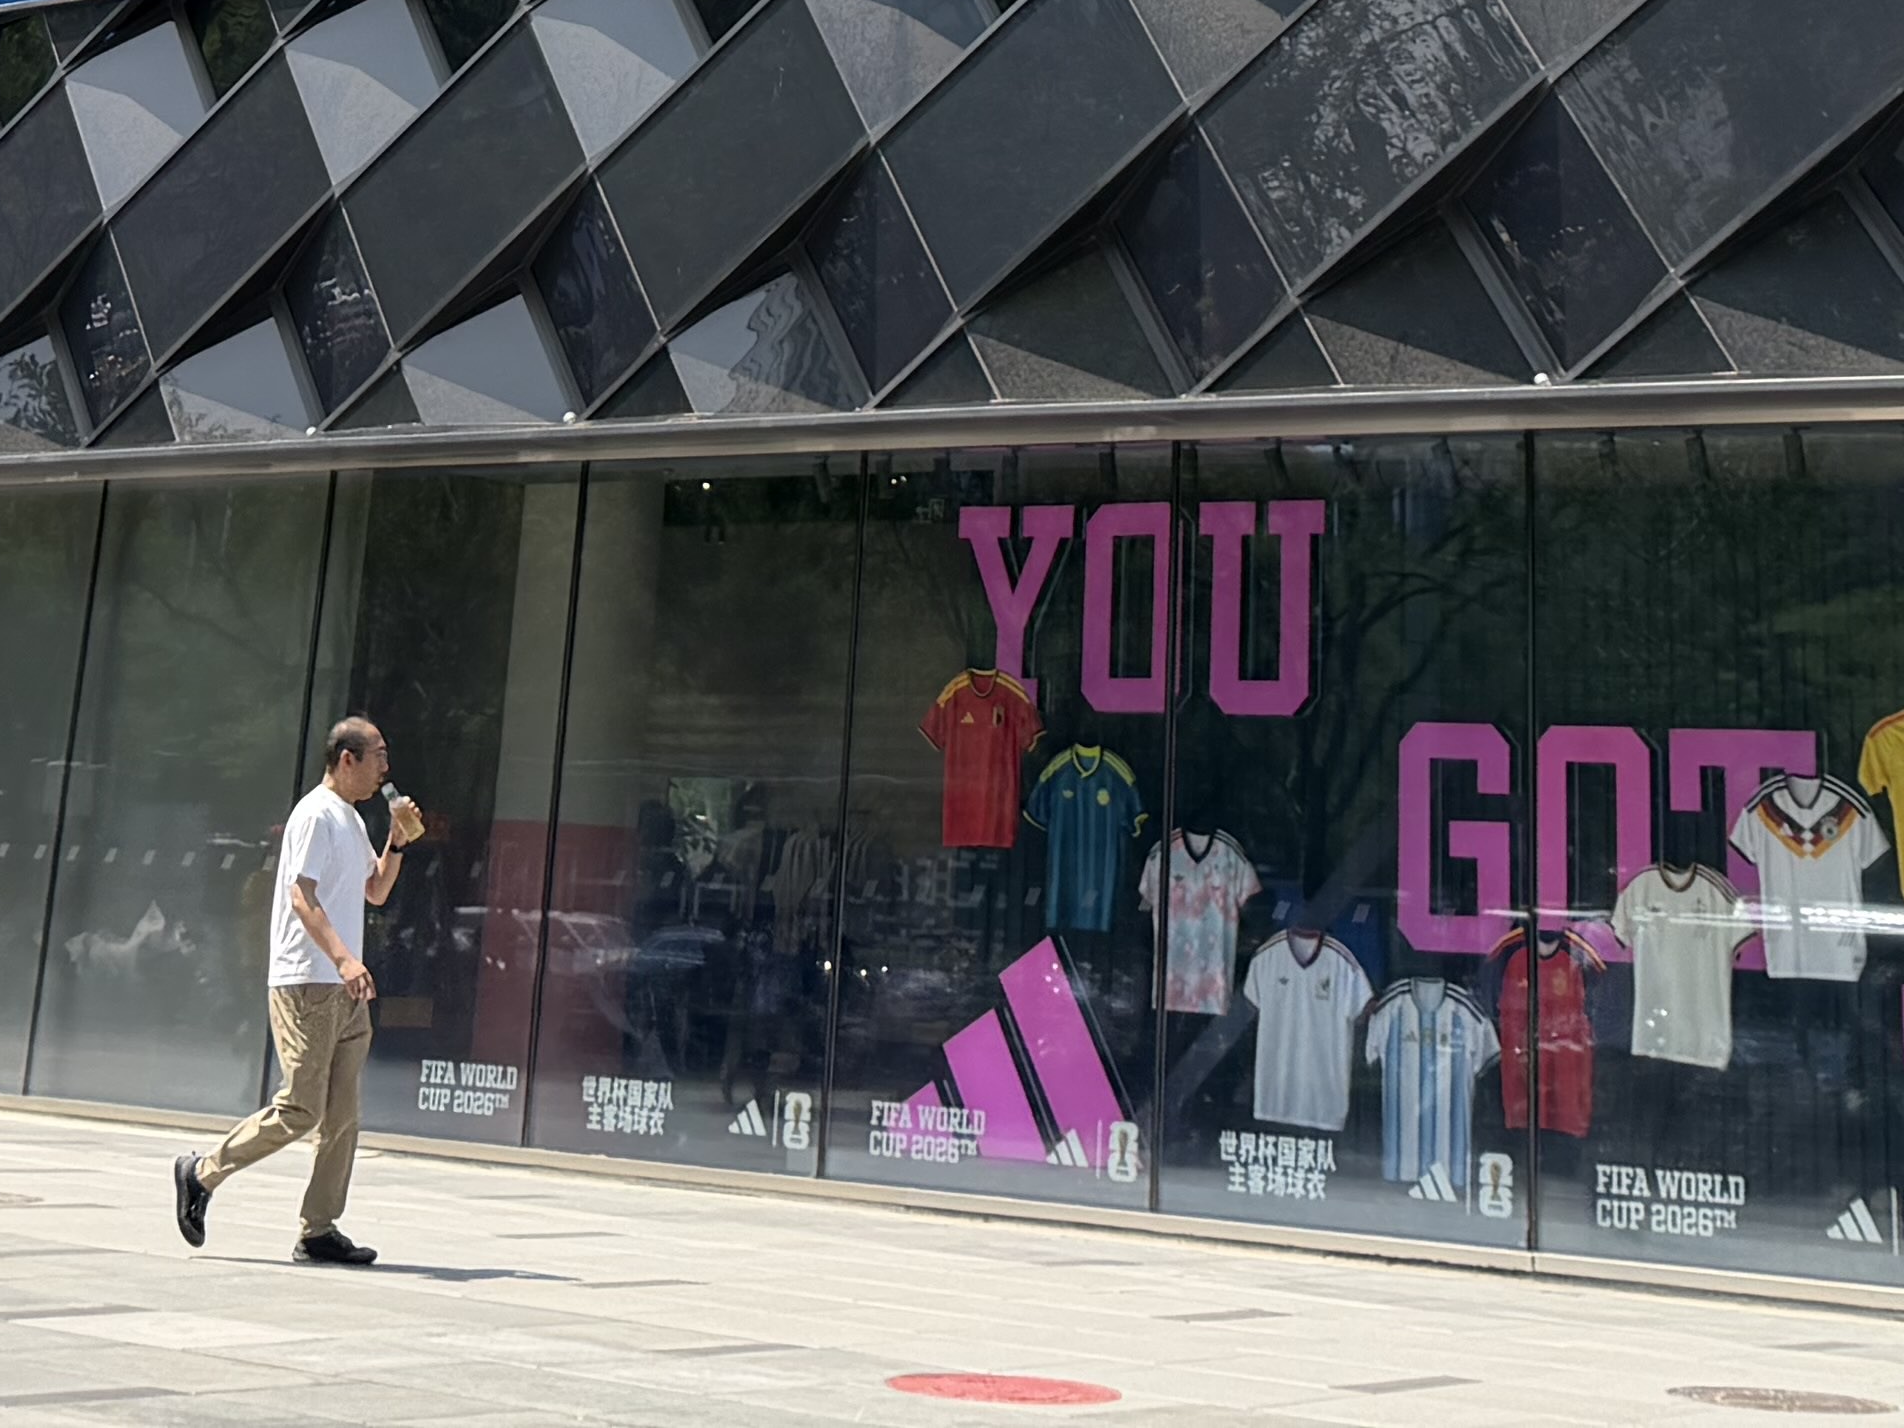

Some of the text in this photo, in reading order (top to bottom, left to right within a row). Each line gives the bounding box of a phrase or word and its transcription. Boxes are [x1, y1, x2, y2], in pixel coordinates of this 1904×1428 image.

[958, 500, 1325, 716] YOU
[1397, 721, 1816, 971] GOT
[420, 1059, 518, 1090] FIFA WORLD
[418, 1088, 451, 1112] CUP
[582, 1075, 674, 1110] 世界杯国家队
[586, 1105, 665, 1135] 主客场球衣
[871, 1100, 986, 1136] FIFA WORLD
[869, 1131, 906, 1158] CUP
[1219, 1130, 1336, 1172] 世界杯国家队
[1228, 1162, 1326, 1200] 主客场球衣
[1596, 1164, 1746, 1206] FIFA WORLD
[1596, 1199, 1645, 1231] CUP
